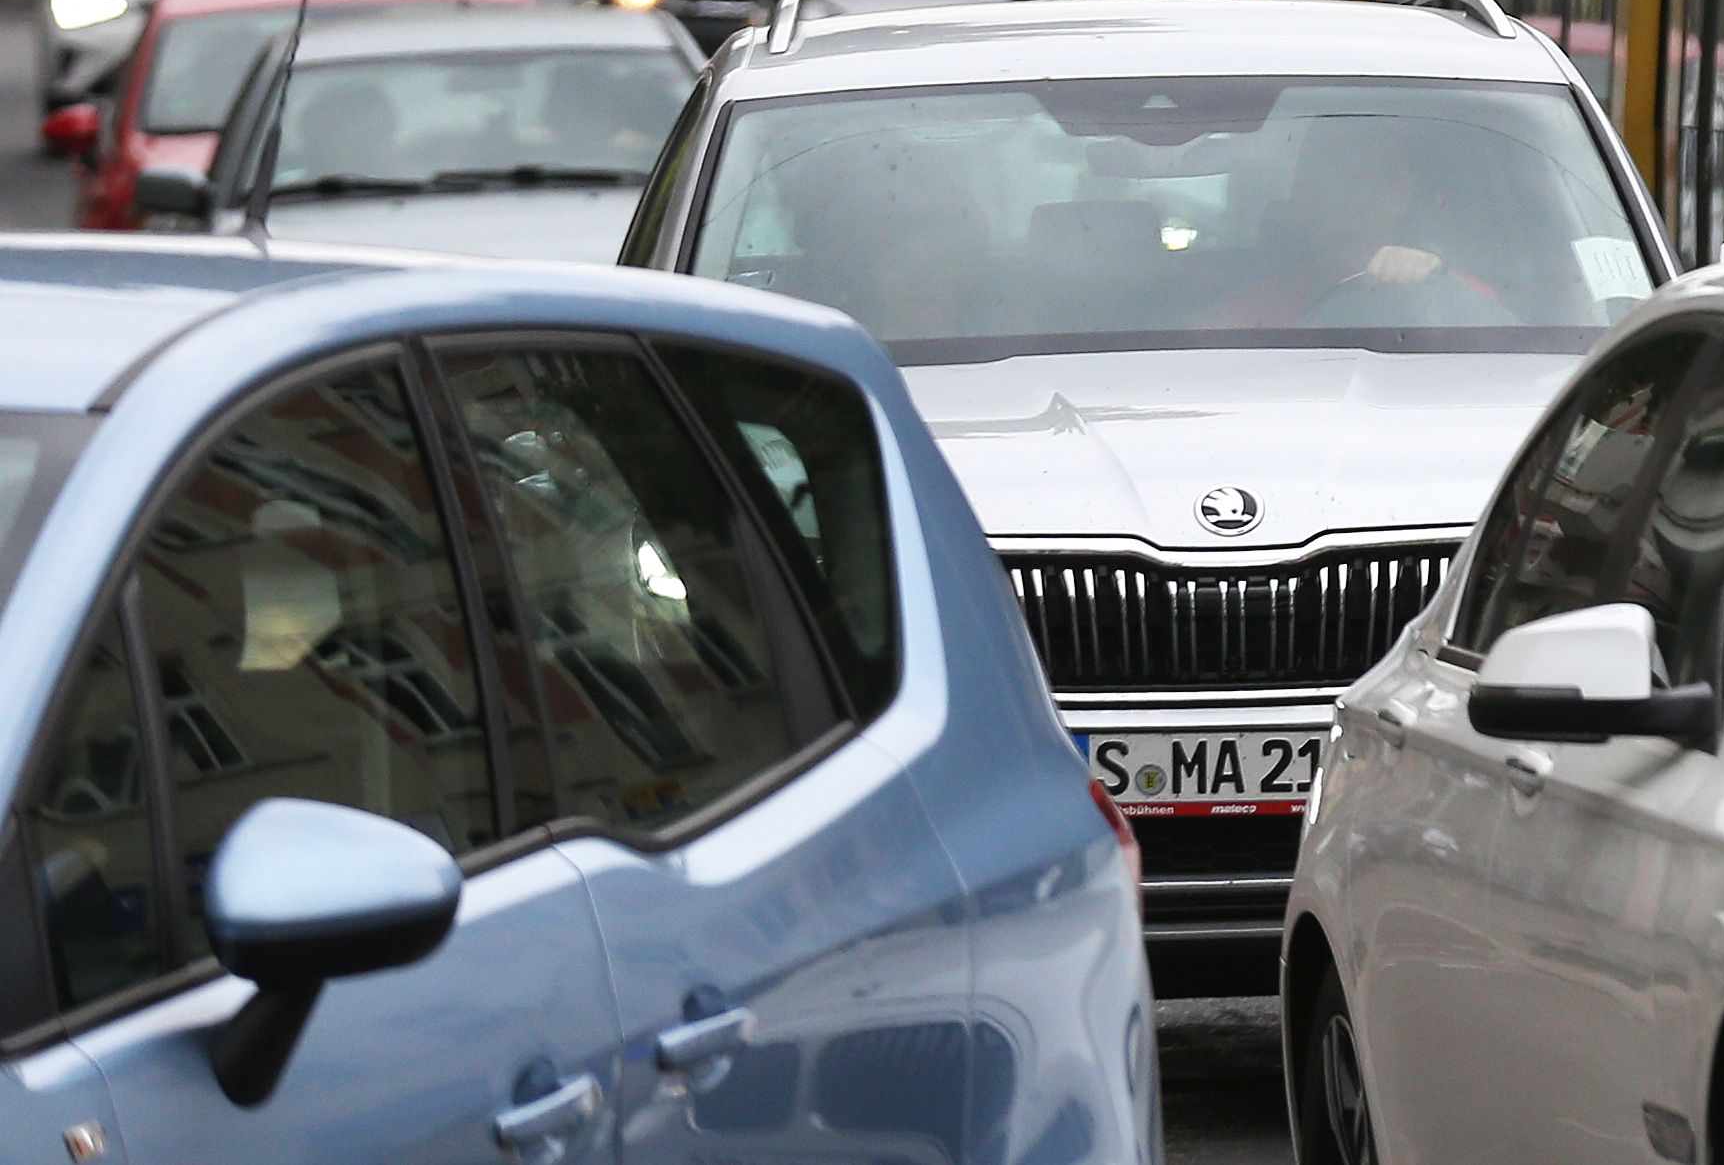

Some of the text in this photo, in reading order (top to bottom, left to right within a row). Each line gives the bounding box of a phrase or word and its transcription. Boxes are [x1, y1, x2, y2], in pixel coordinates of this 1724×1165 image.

[1096, 738, 1321, 796] S MA 21
[1119, 804, 1174, 816] sbühnen
